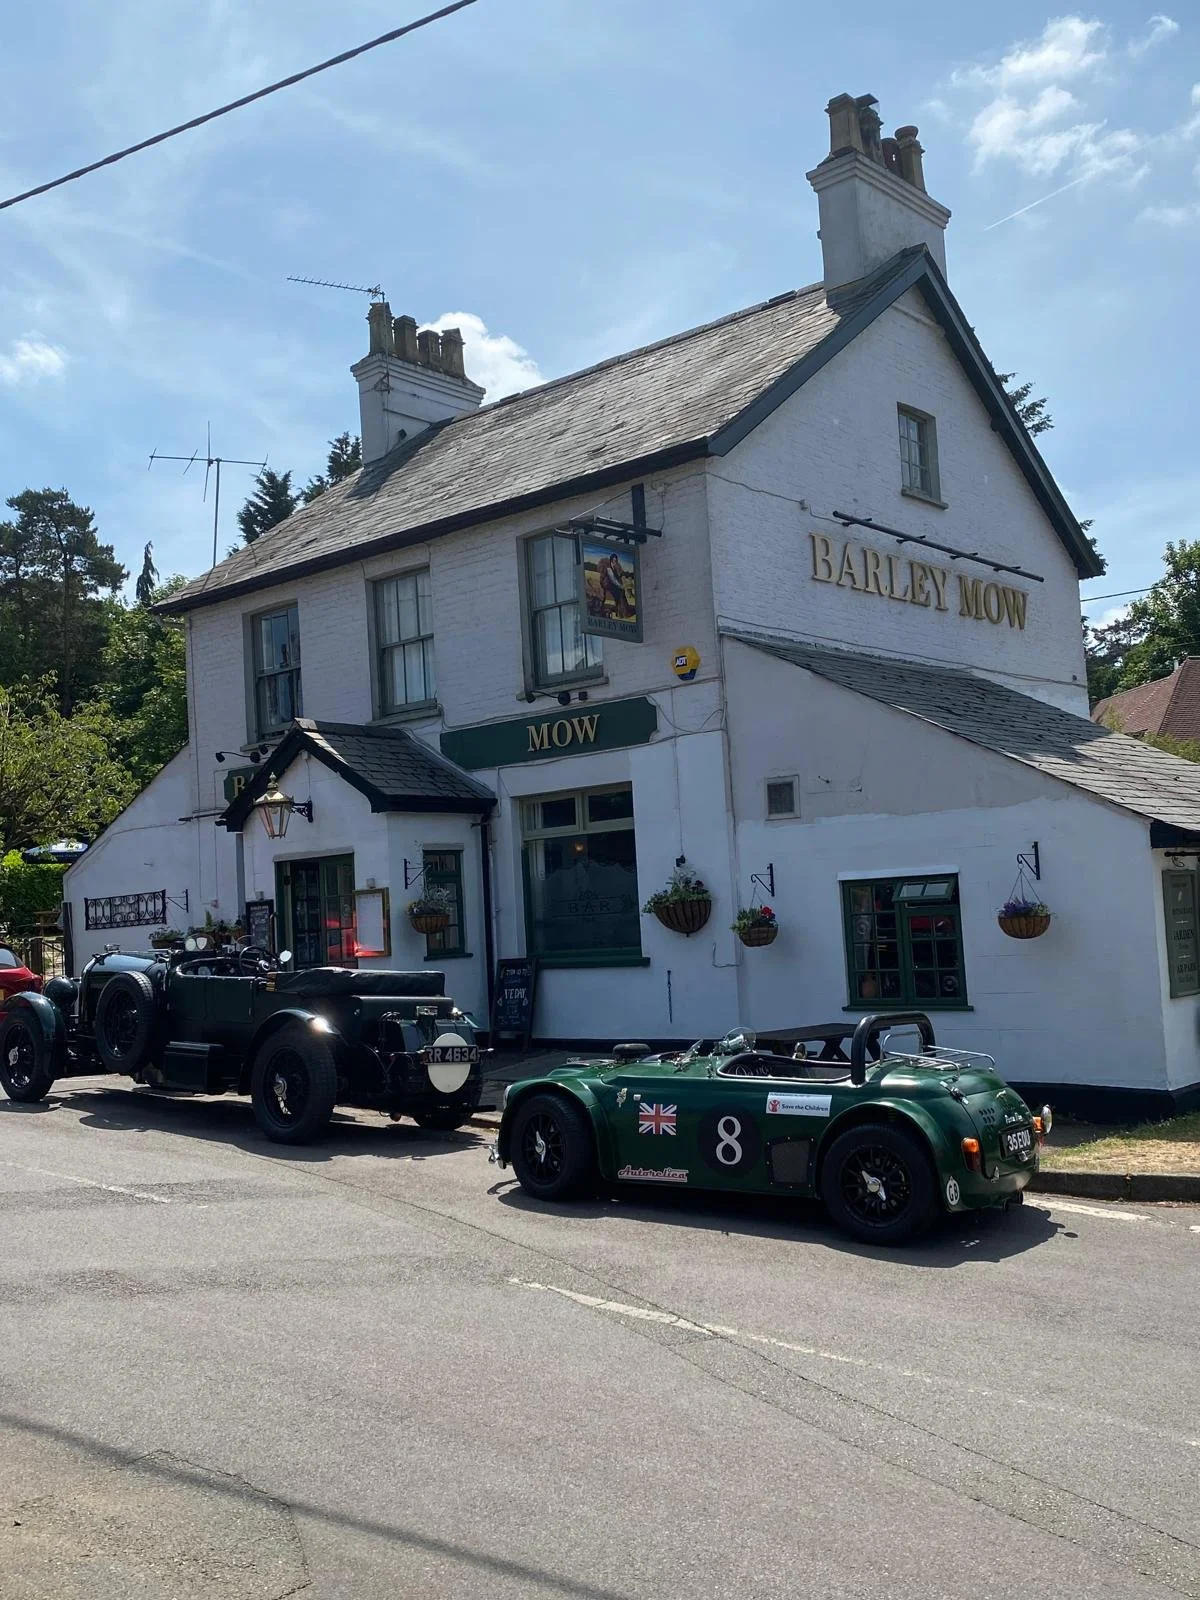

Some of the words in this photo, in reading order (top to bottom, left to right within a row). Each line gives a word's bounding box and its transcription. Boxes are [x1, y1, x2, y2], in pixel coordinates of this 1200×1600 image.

[809, 531, 949, 611] BARLEY
[957, 573, 1029, 630] MOW
[619, 622, 639, 633] MOW
[675, 656, 688, 666] ADT
[526, 714, 600, 752] MOW
[568, 901, 611, 913] BAR
[445, 1047, 477, 1062] 4634
[781, 1103, 795, 1111] Save
[804, 1104, 829, 1112] Children
[715, 1115, 743, 1165] 8
